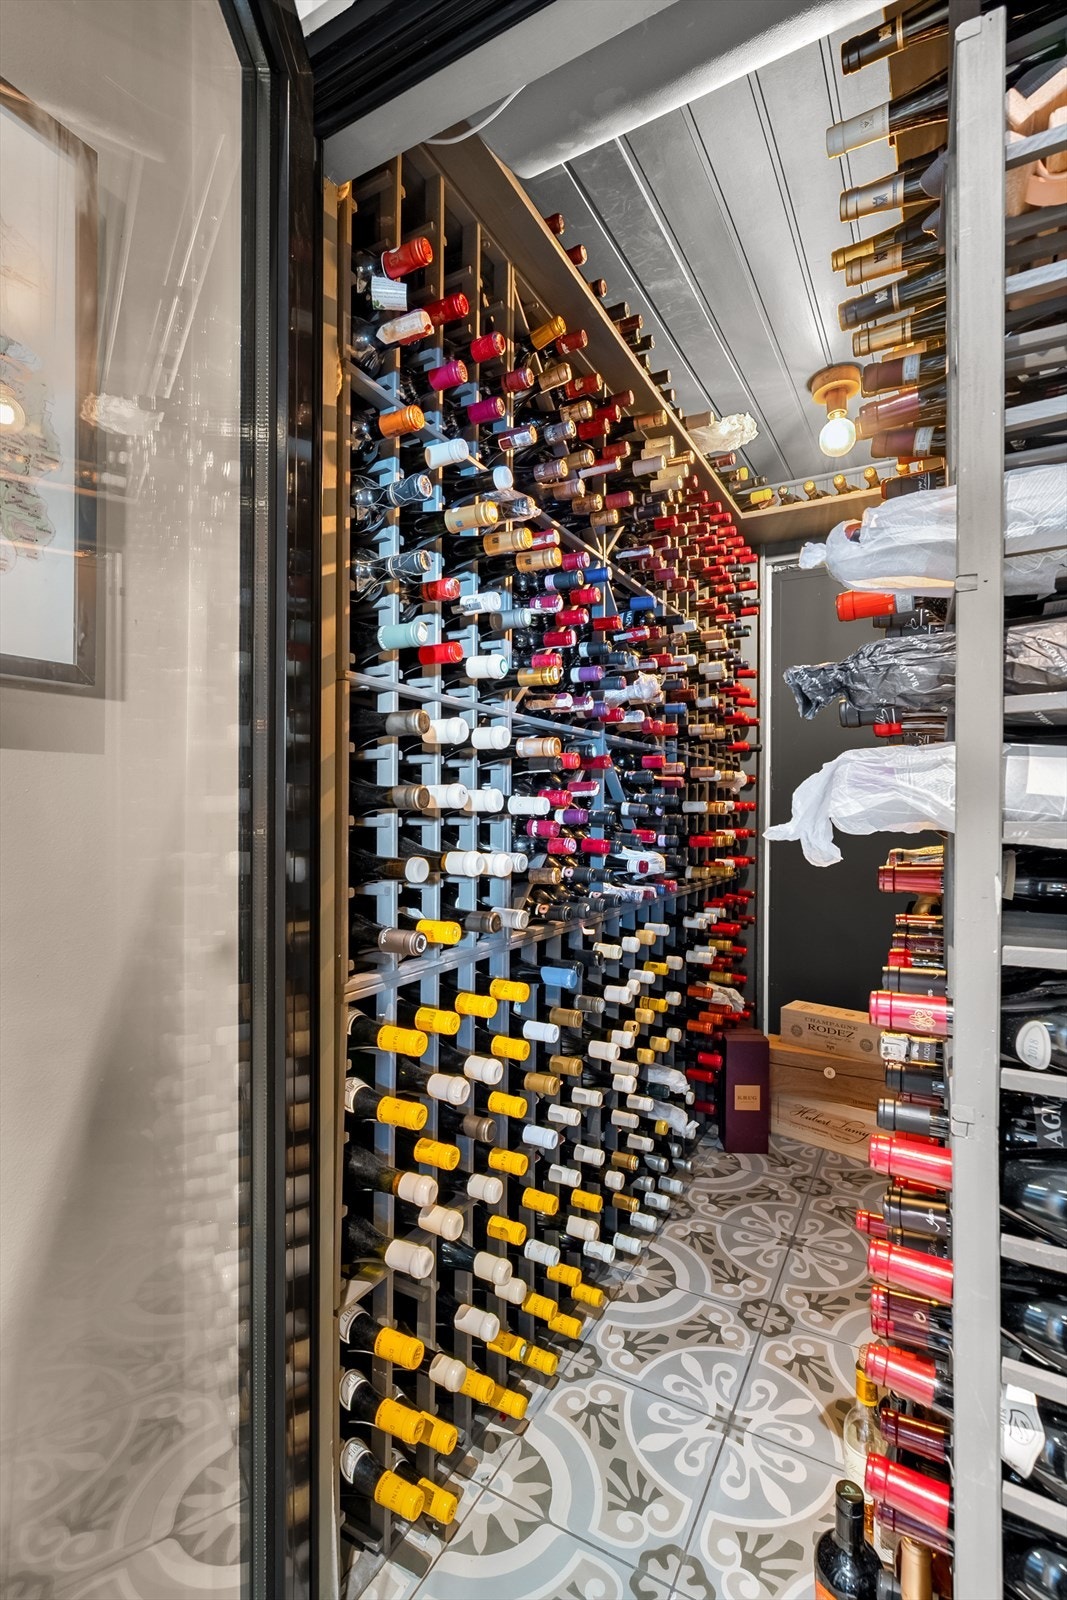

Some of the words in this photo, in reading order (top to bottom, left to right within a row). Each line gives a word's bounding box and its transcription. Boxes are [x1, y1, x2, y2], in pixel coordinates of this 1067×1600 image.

[804, 1016, 859, 1032] CHAMPAGNE
[807, 1023, 856, 1040] RODEZ
[1027, 1038, 1040, 1061] 2018
[790, 1103, 832, 1127] Hubert
[831, 1120, 871, 1145] Lamy
